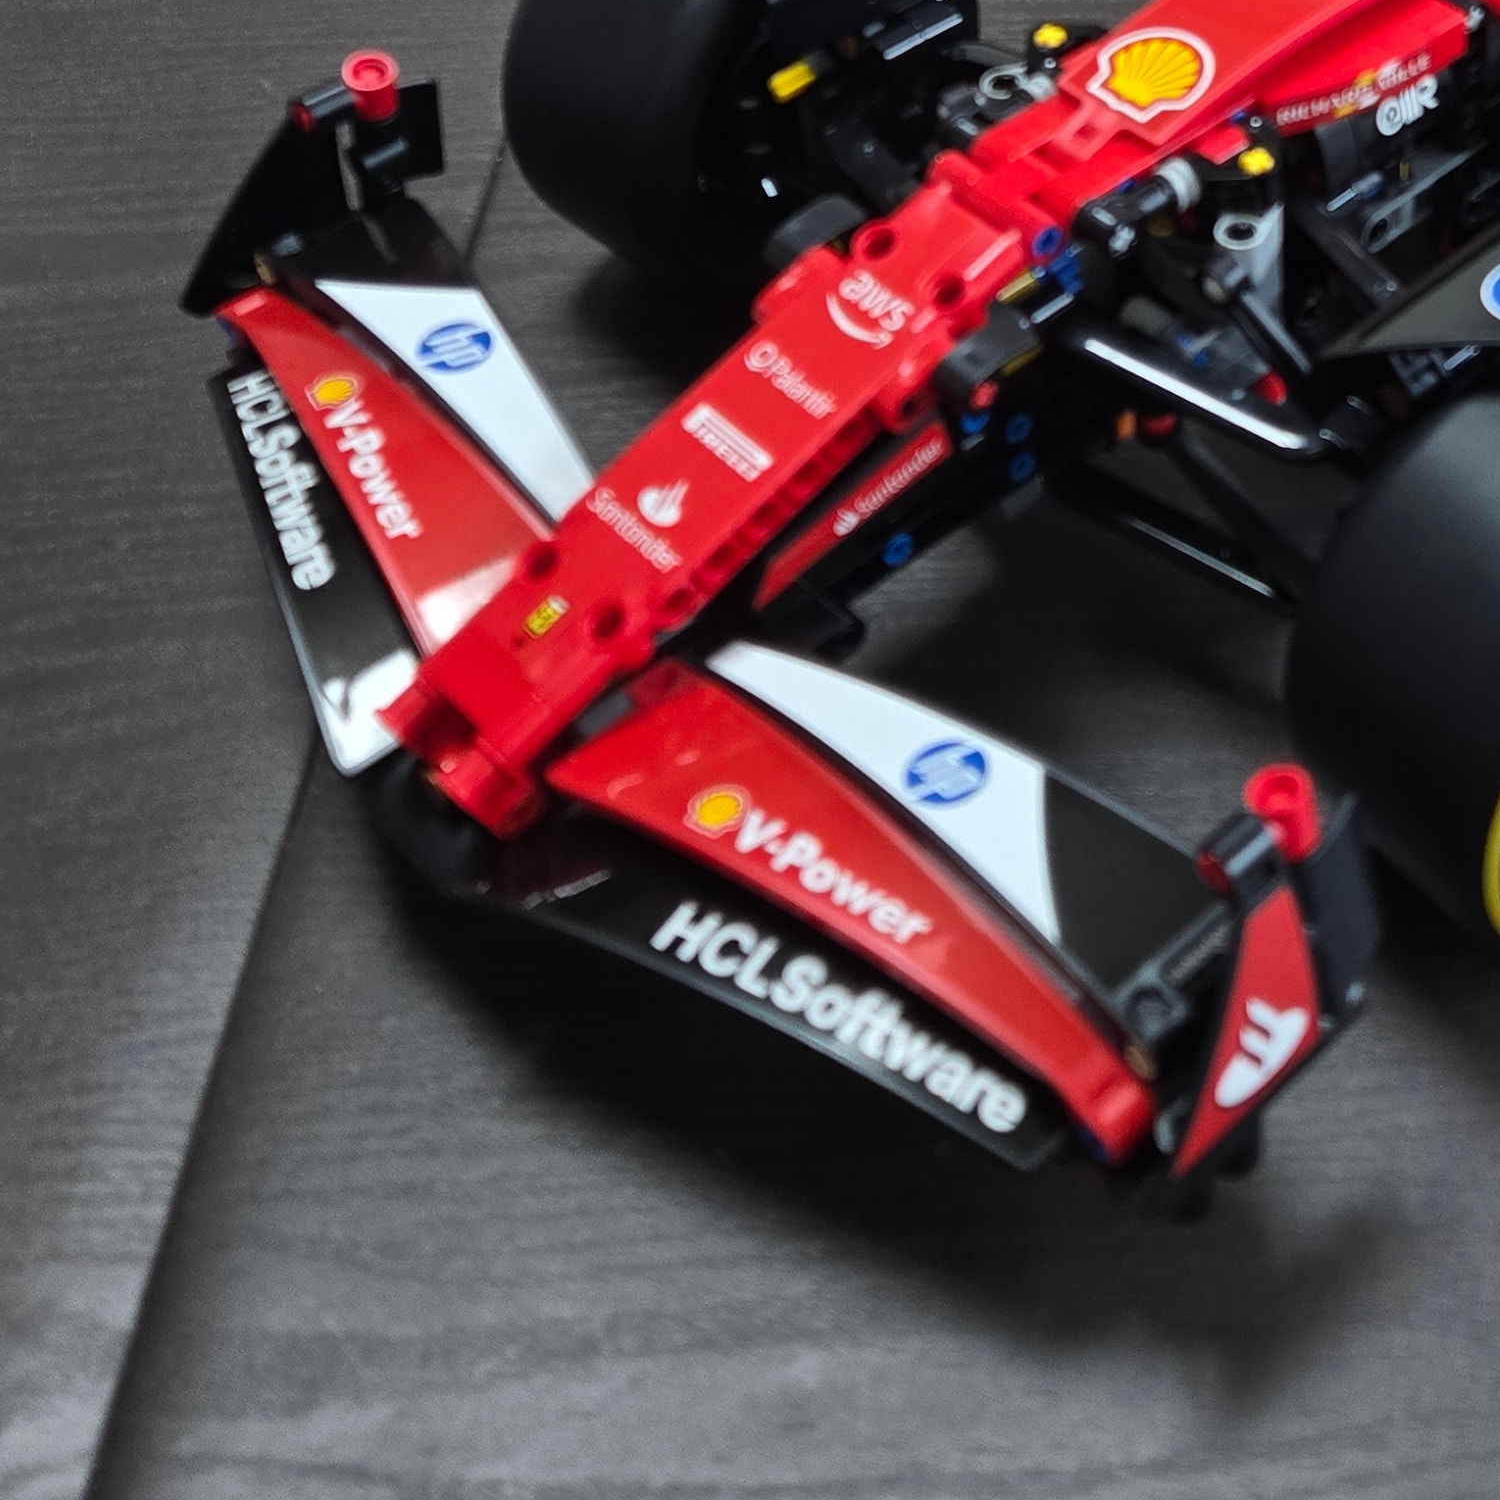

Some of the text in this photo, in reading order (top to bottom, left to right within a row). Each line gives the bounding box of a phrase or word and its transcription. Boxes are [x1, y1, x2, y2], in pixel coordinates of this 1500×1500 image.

[838, 269, 916, 332] aws
[770, 355, 839, 421] Palantir
[226, 368, 337, 591] HCLSoftware
[324, 400, 423, 540] V-Power
[734, 807, 933, 944] V-Power
[649, 900, 1028, 1133] HCLSoftware
